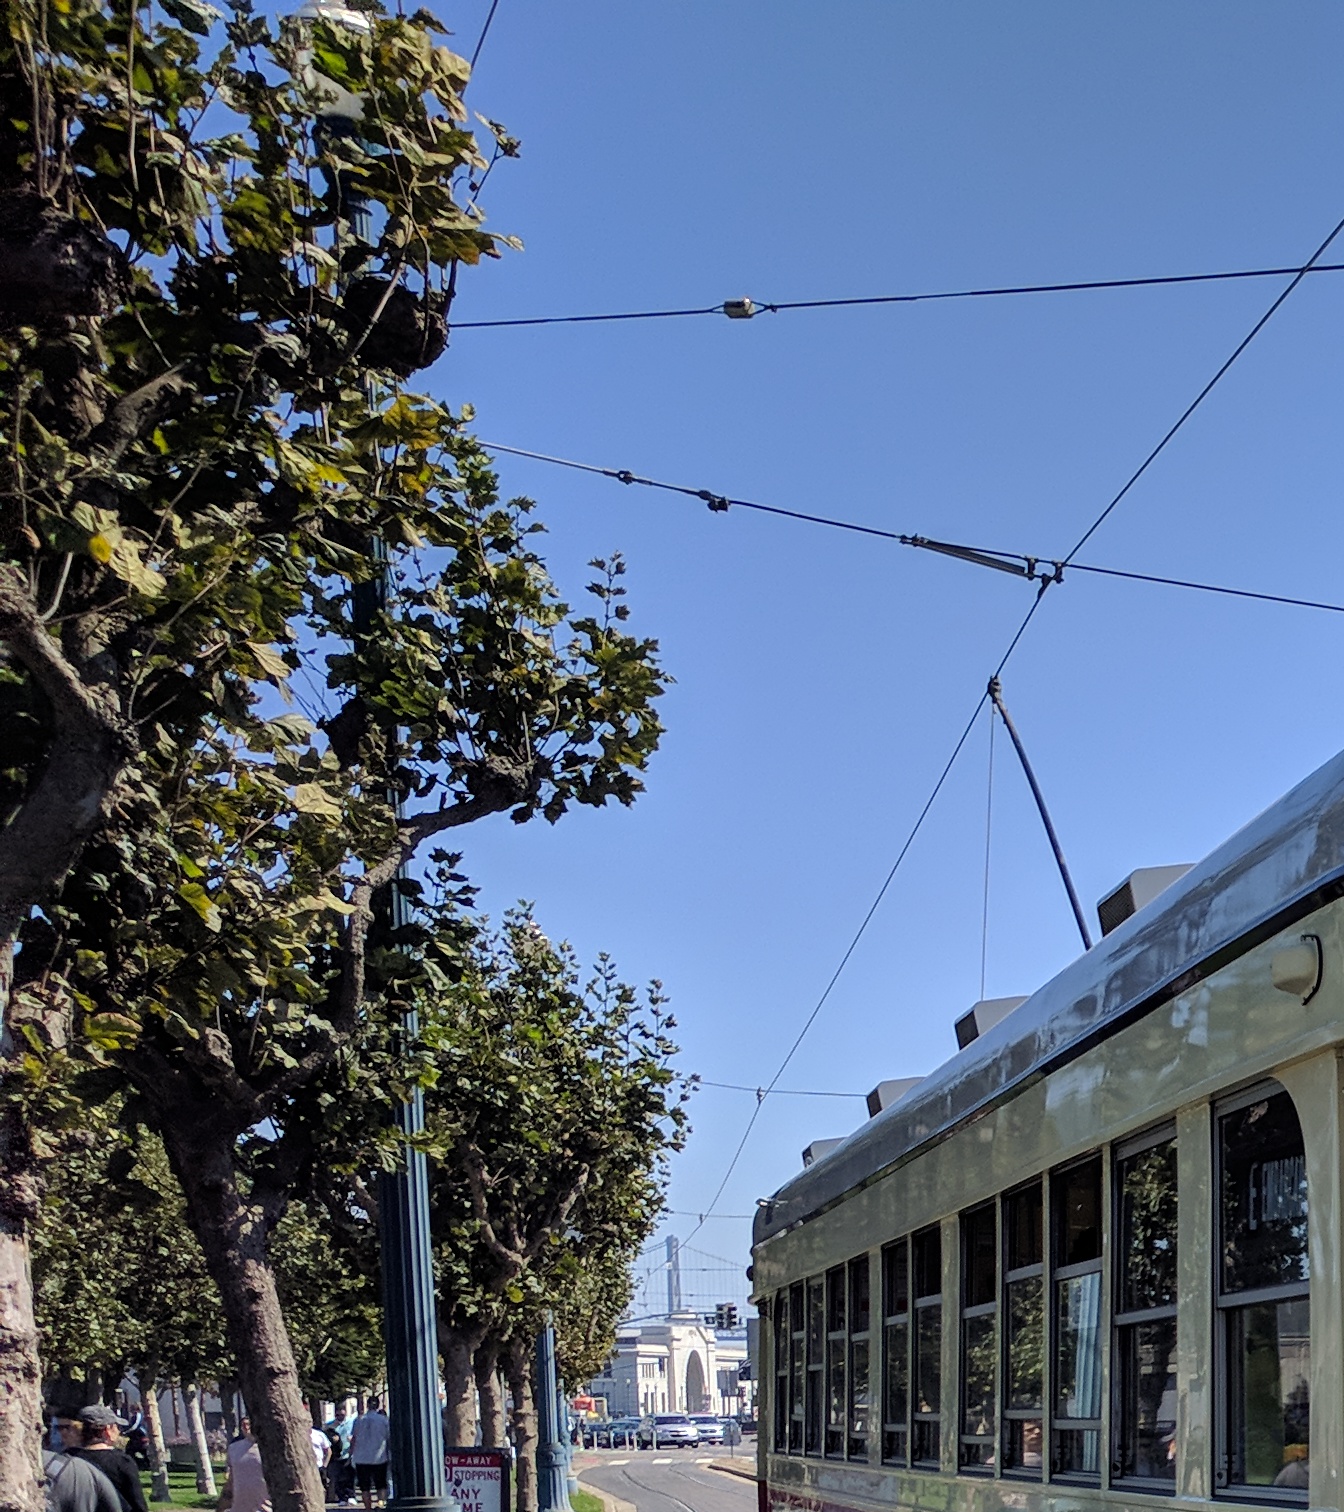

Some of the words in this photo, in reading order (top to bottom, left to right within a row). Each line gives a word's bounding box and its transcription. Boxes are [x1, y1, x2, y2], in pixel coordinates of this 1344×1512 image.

[445, 1456, 492, 1465] OW-AWAY
[454, 1470, 500, 1481] STOPPING
[451, 1488, 481, 1500] ANY
